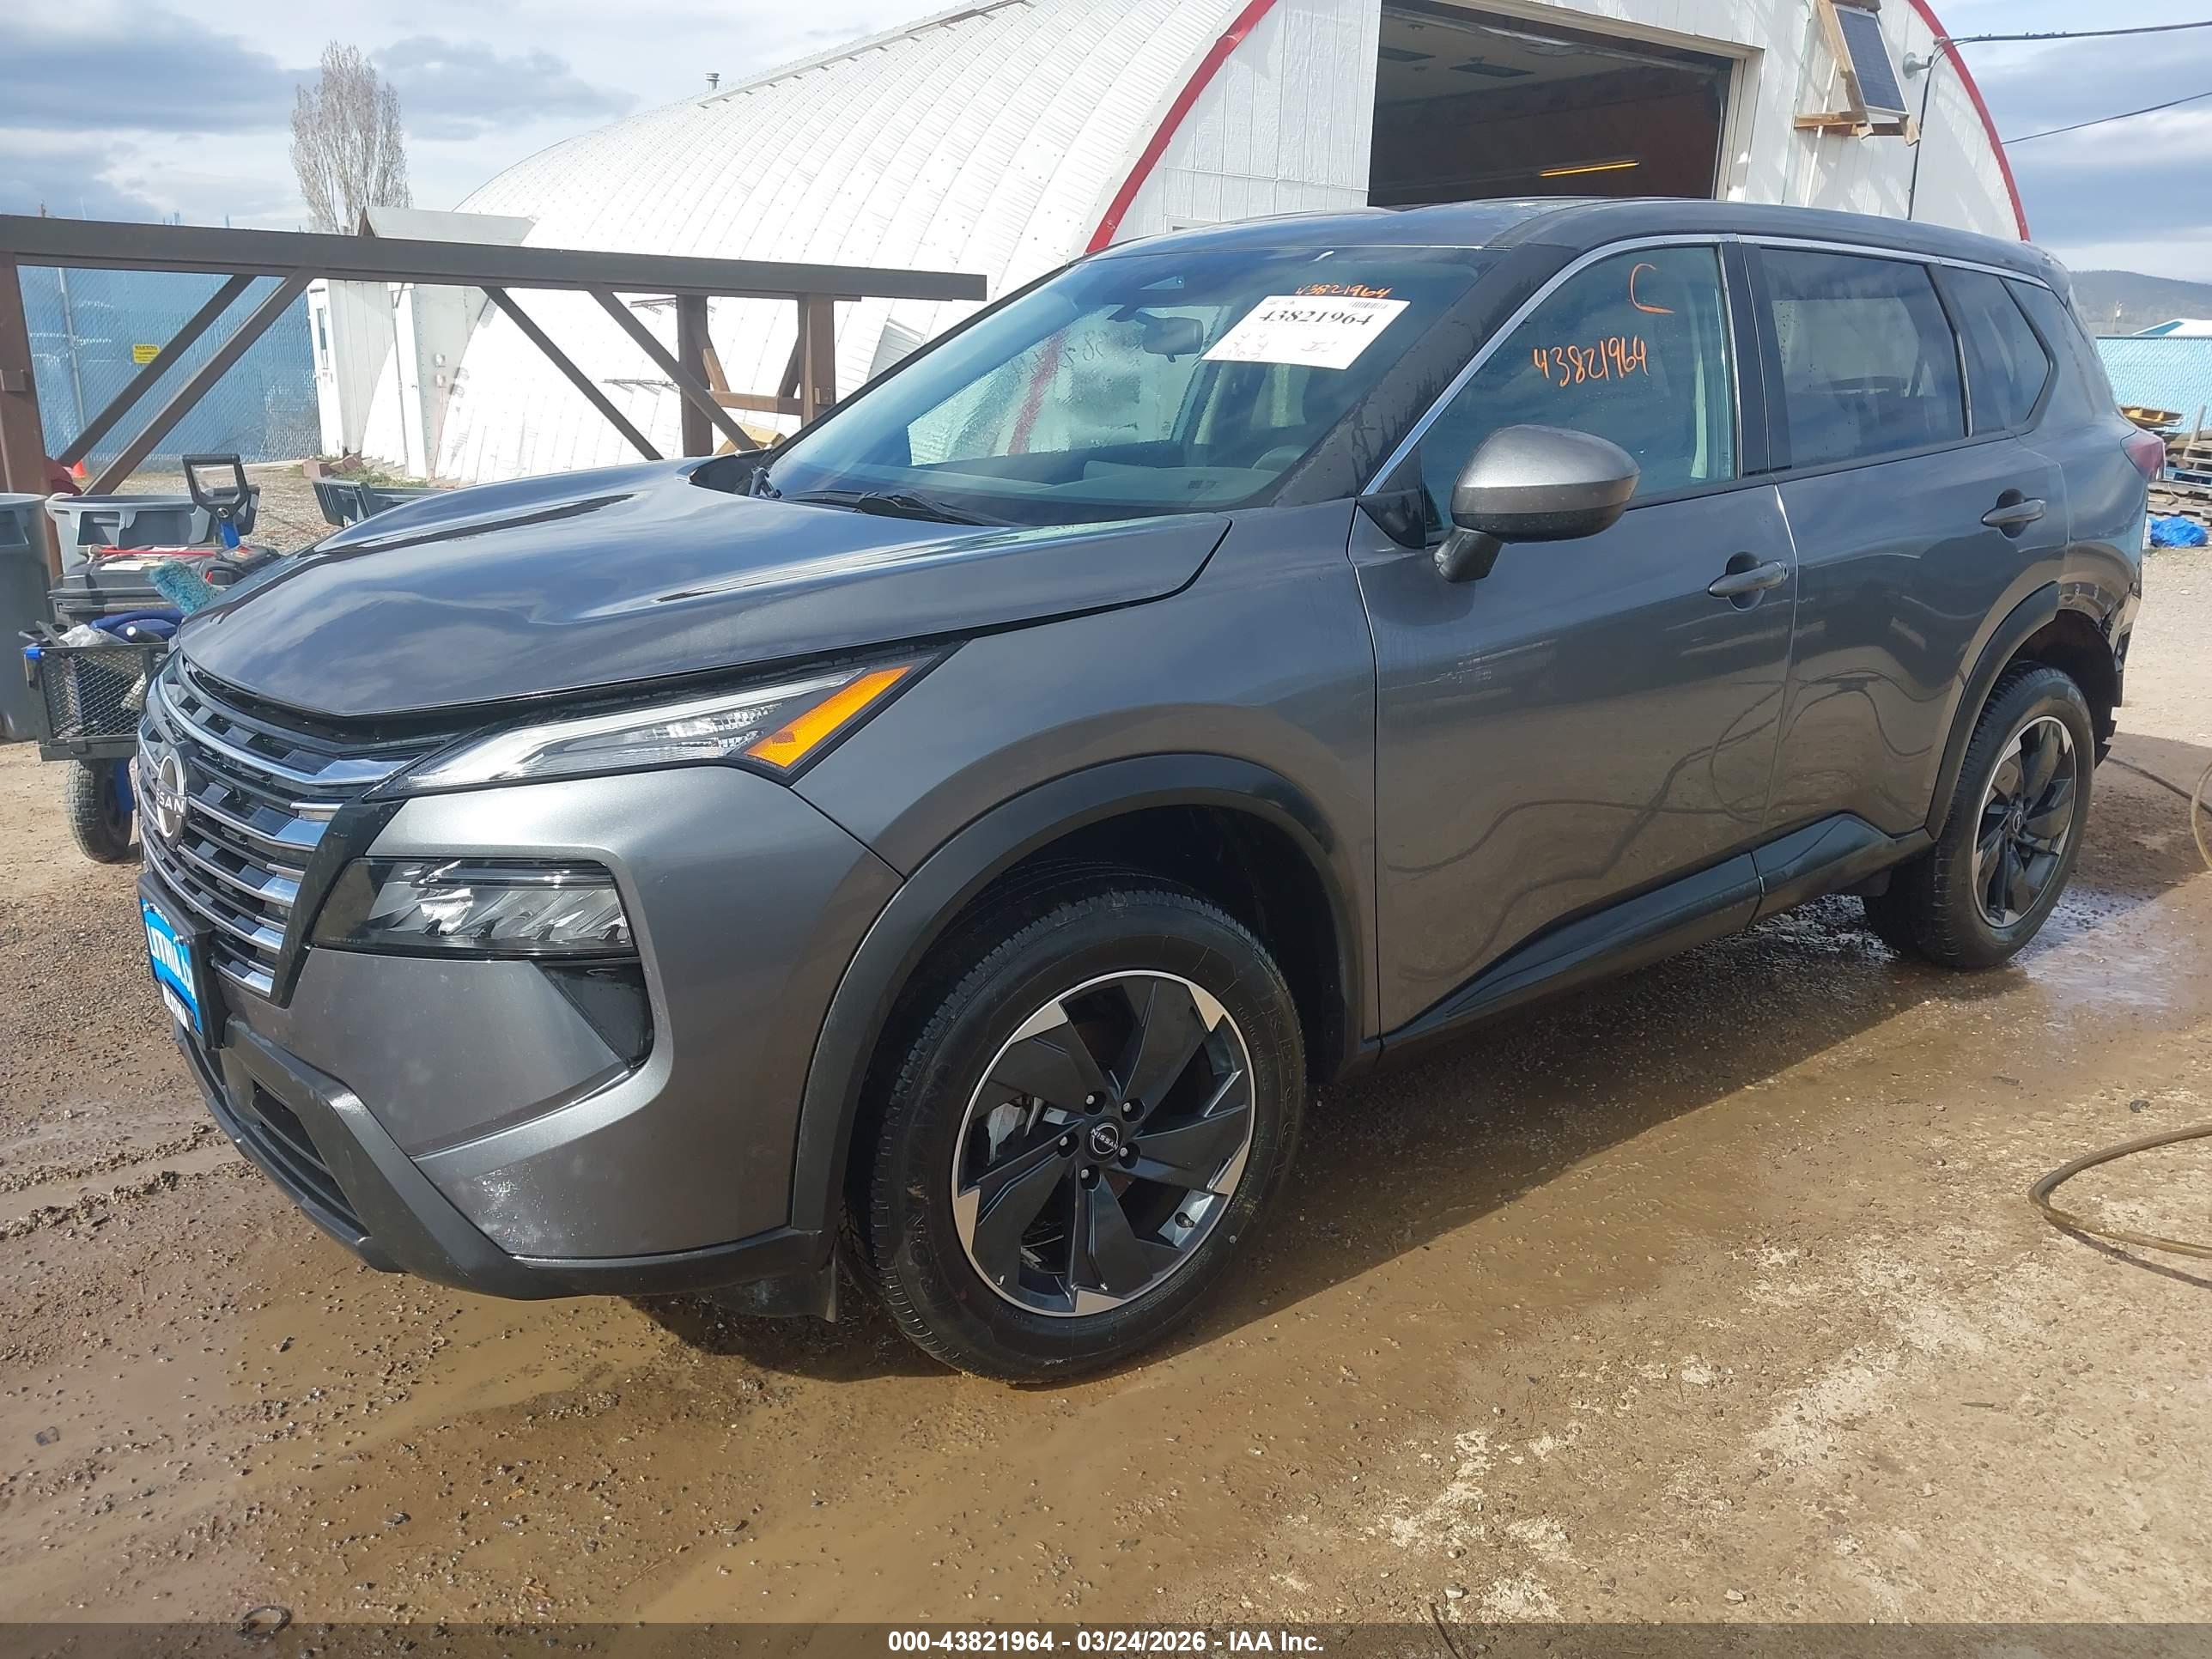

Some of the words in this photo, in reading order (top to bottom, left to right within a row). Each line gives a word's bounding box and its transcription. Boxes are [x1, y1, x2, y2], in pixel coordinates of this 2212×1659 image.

[1295, 284, 1394, 298] 43821964
[1259, 310, 1374, 325] 43821964
[1534, 335, 1649, 386] 43821964
[1091, 1127, 1118, 1150] NISSAN
